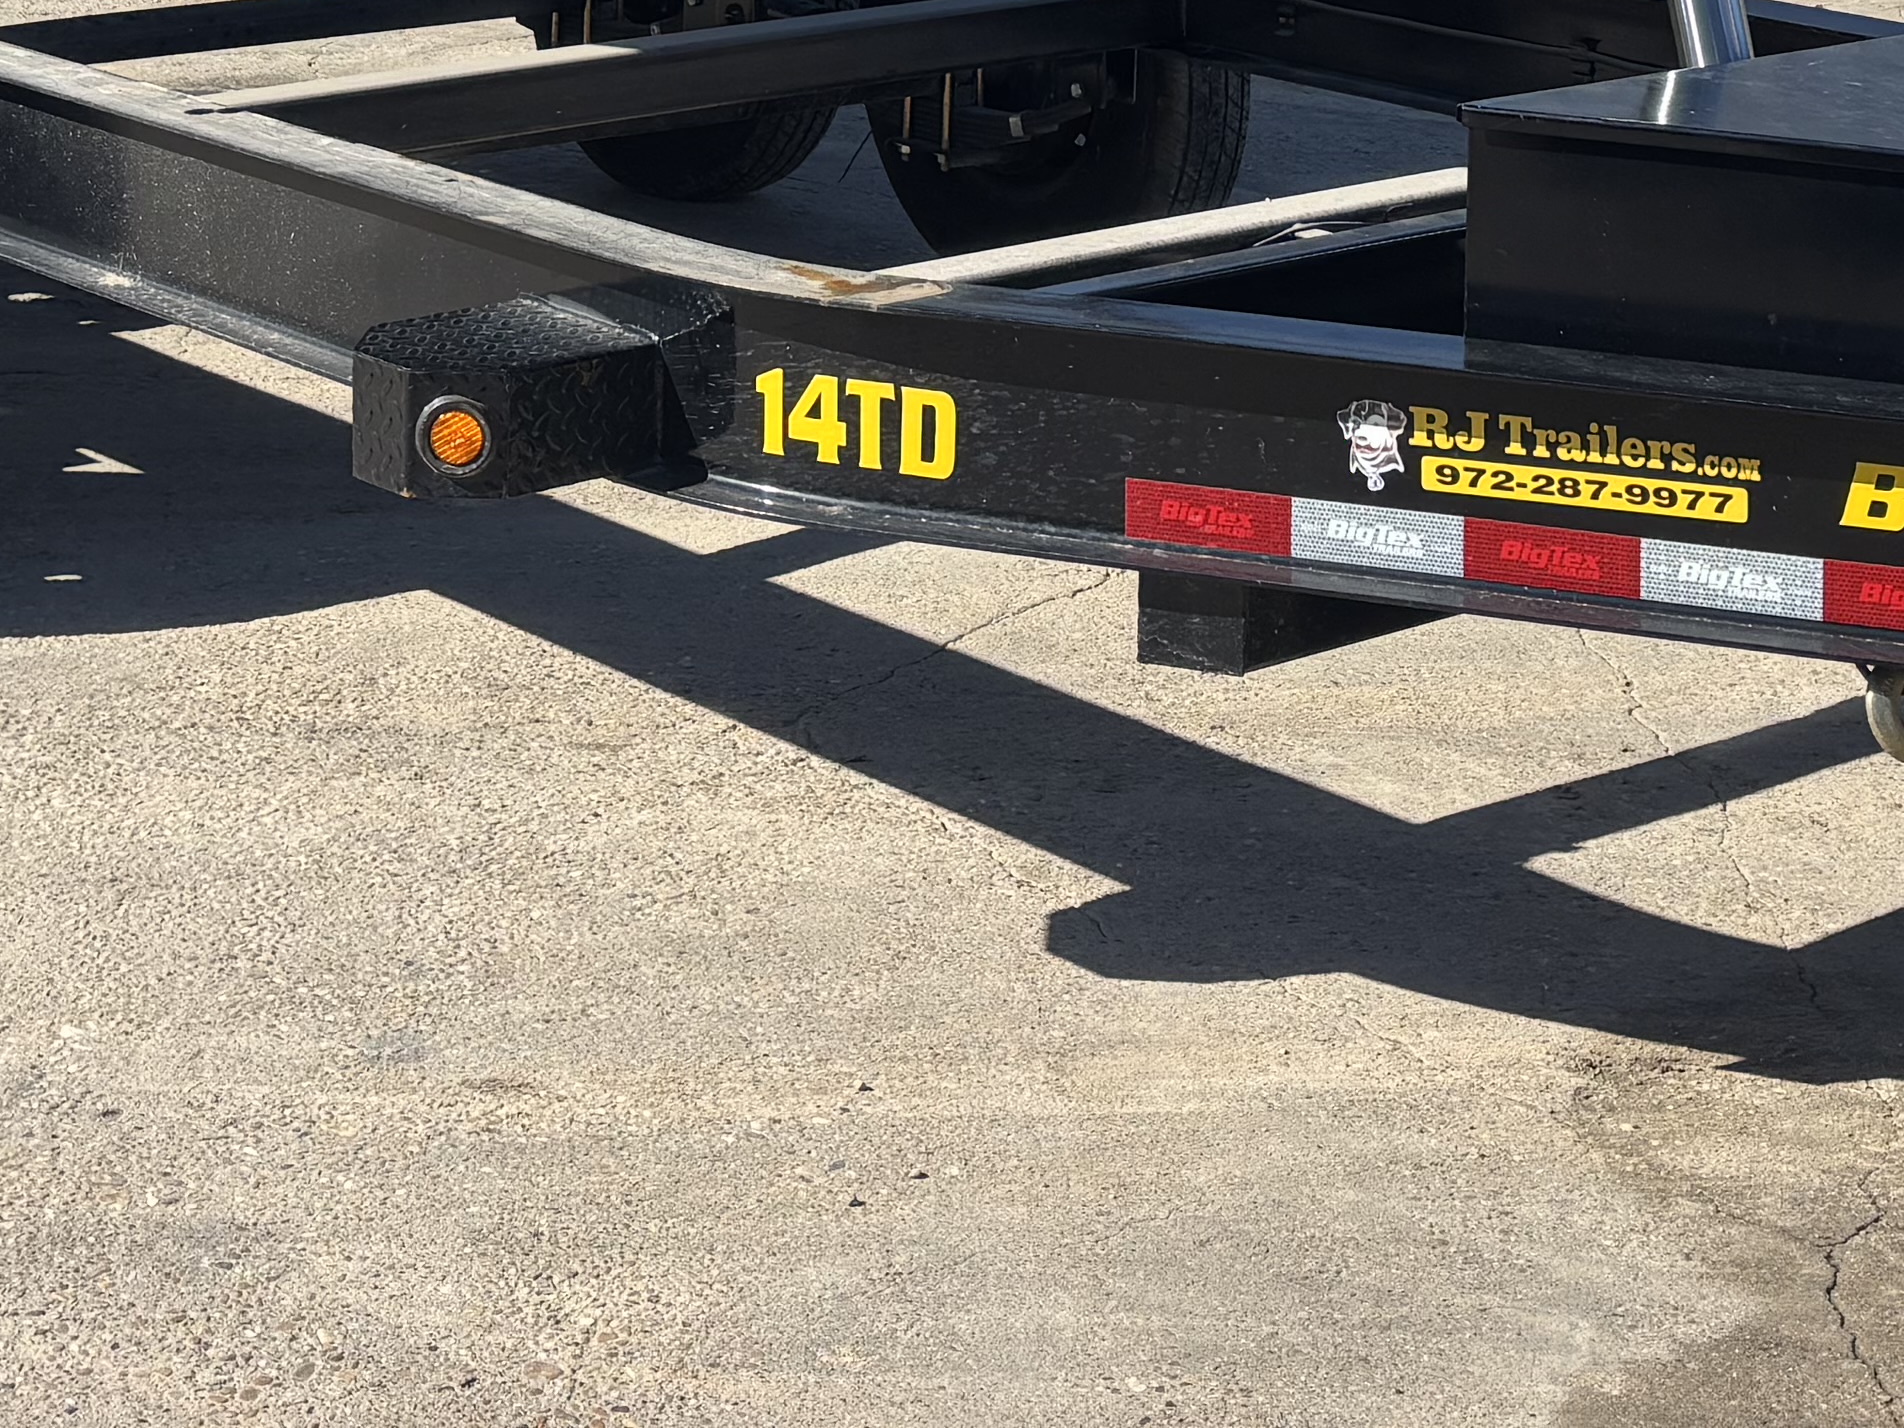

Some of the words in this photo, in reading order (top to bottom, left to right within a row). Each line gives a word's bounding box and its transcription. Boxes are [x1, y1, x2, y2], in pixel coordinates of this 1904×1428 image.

[755, 367, 957, 481] 14TD
[1408, 405, 1490, 452] RJ
[1434, 464, 1735, 515] 972-287-9977
[1158, 499, 1253, 530] BigTex
[1326, 517, 1425, 549] BigTex
[1499, 539, 1601, 571] BigTex
[1677, 560, 1783, 592] BigTex
